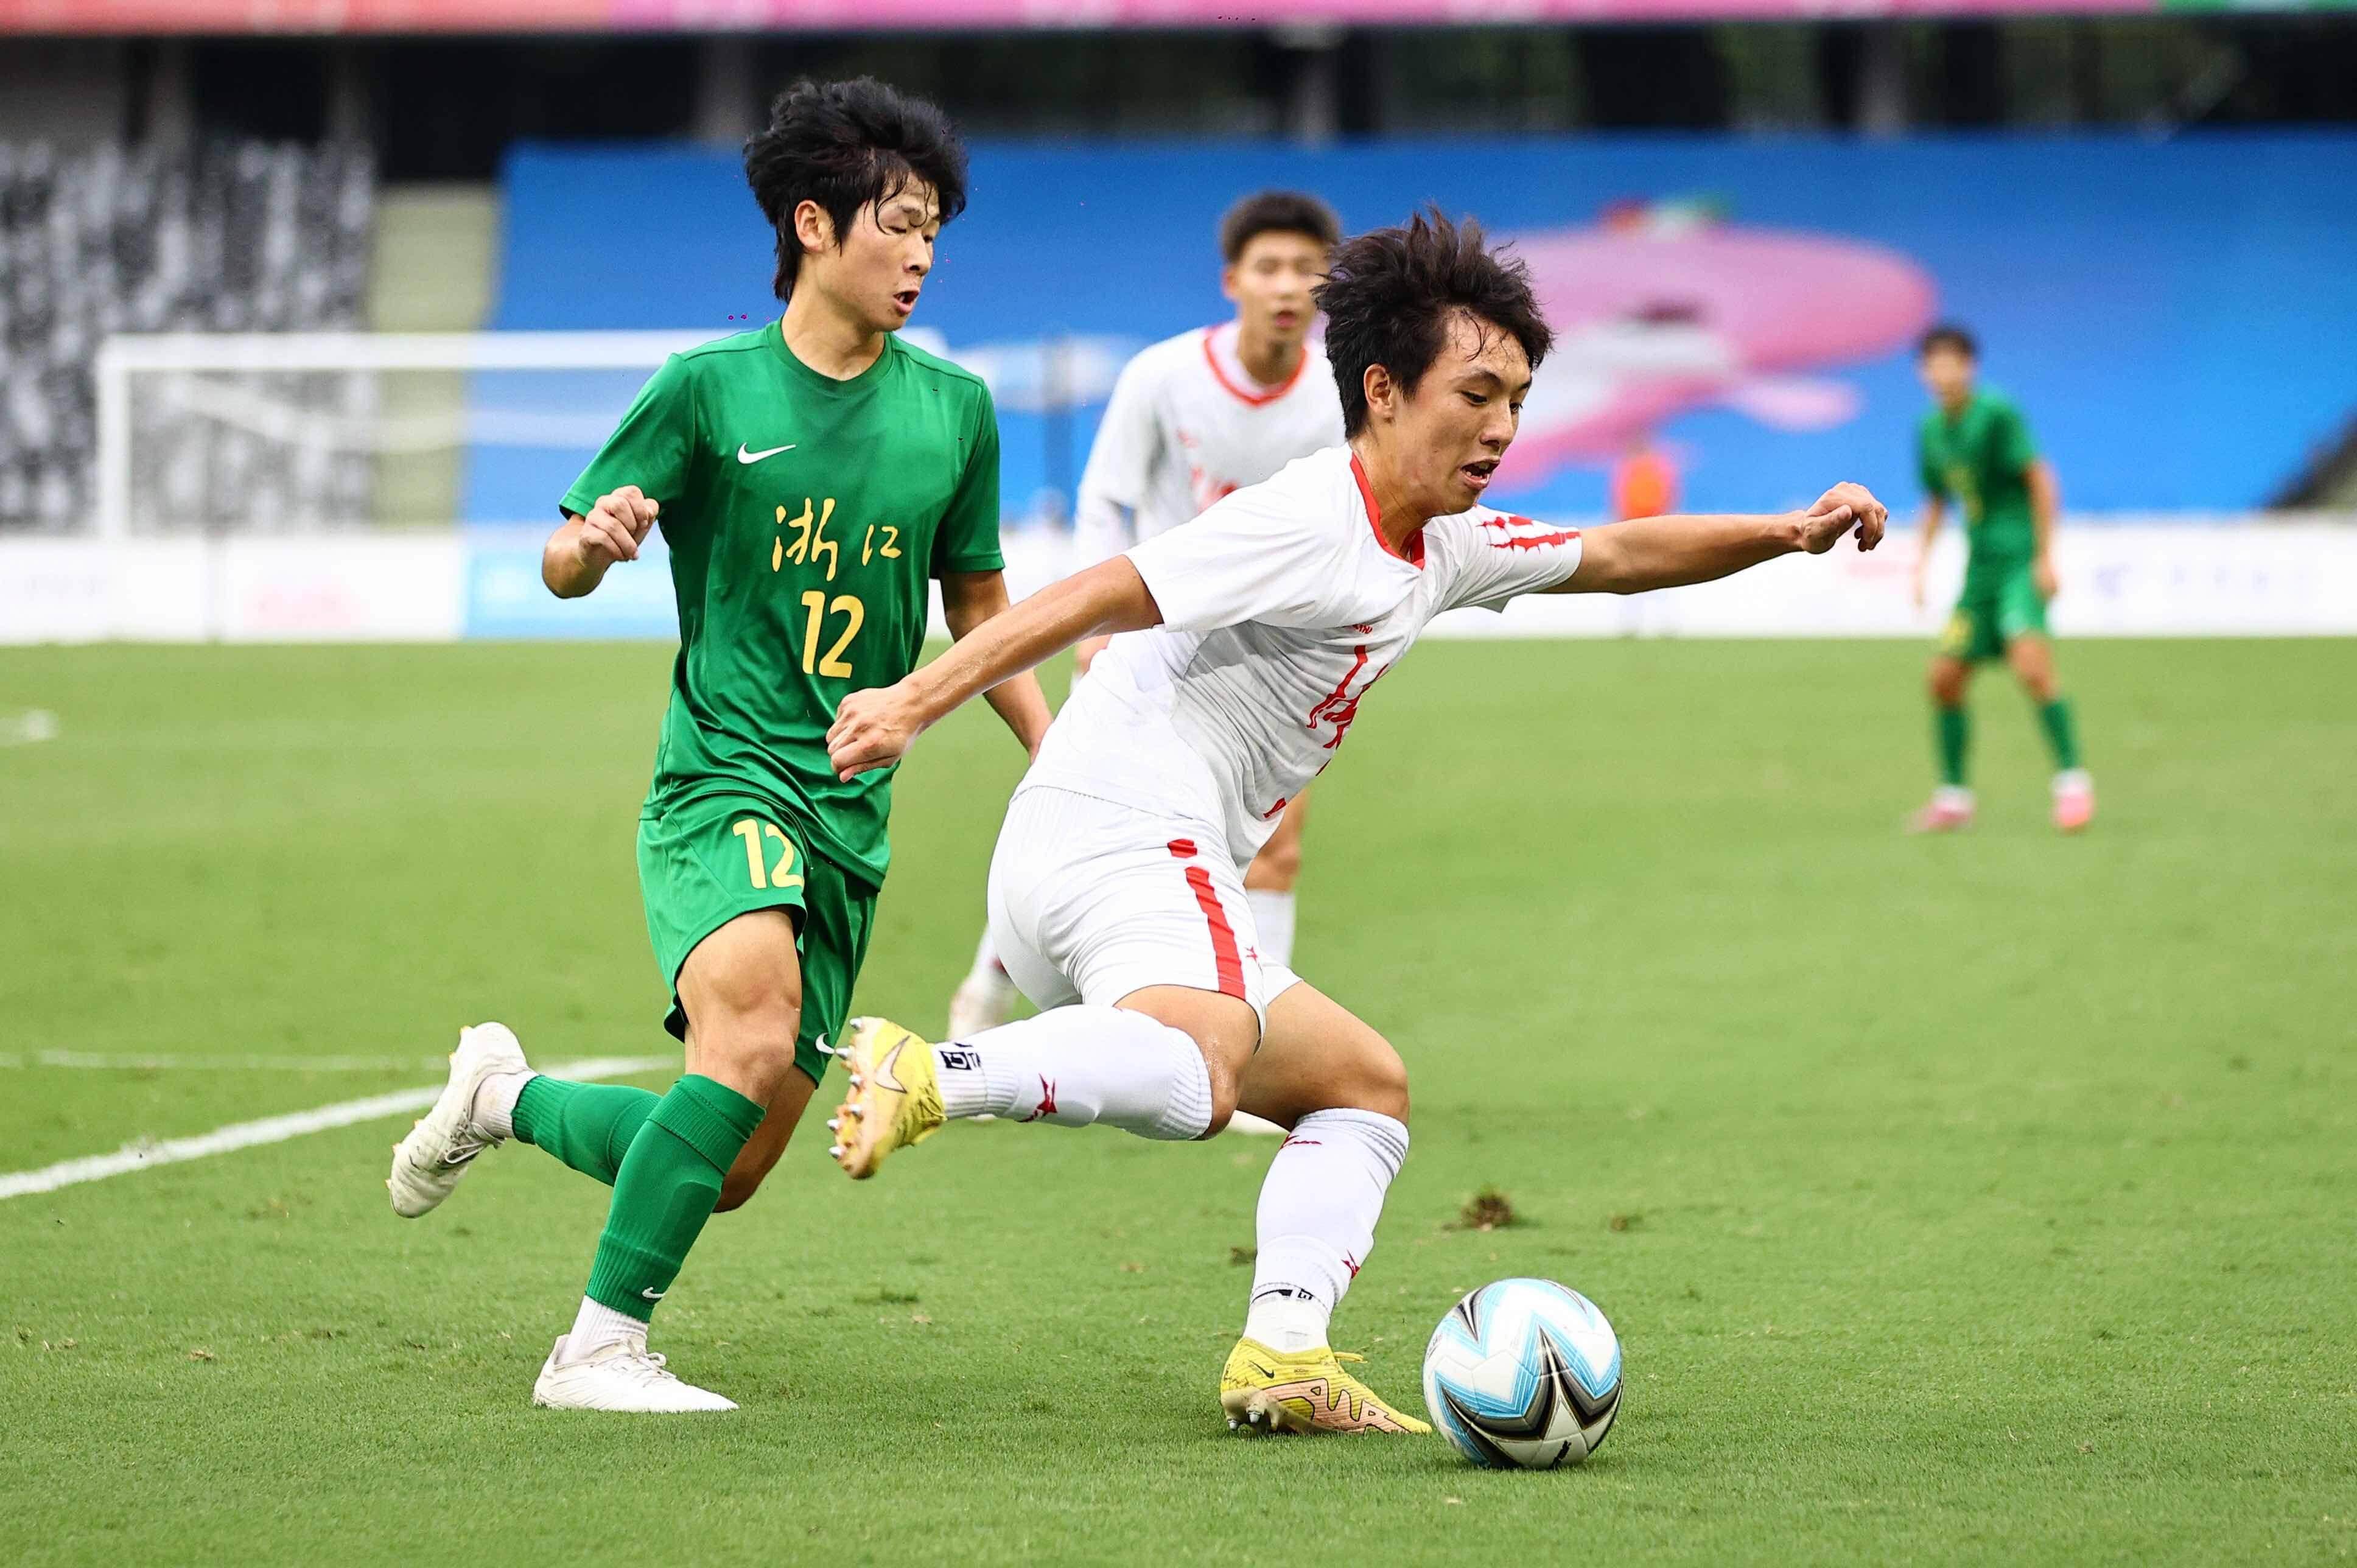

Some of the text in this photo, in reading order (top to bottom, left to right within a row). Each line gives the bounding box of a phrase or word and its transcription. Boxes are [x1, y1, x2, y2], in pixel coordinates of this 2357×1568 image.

[772, 497, 902, 581] 浙江
[800, 590, 865, 679] 12
[732, 818, 805, 892] 12
